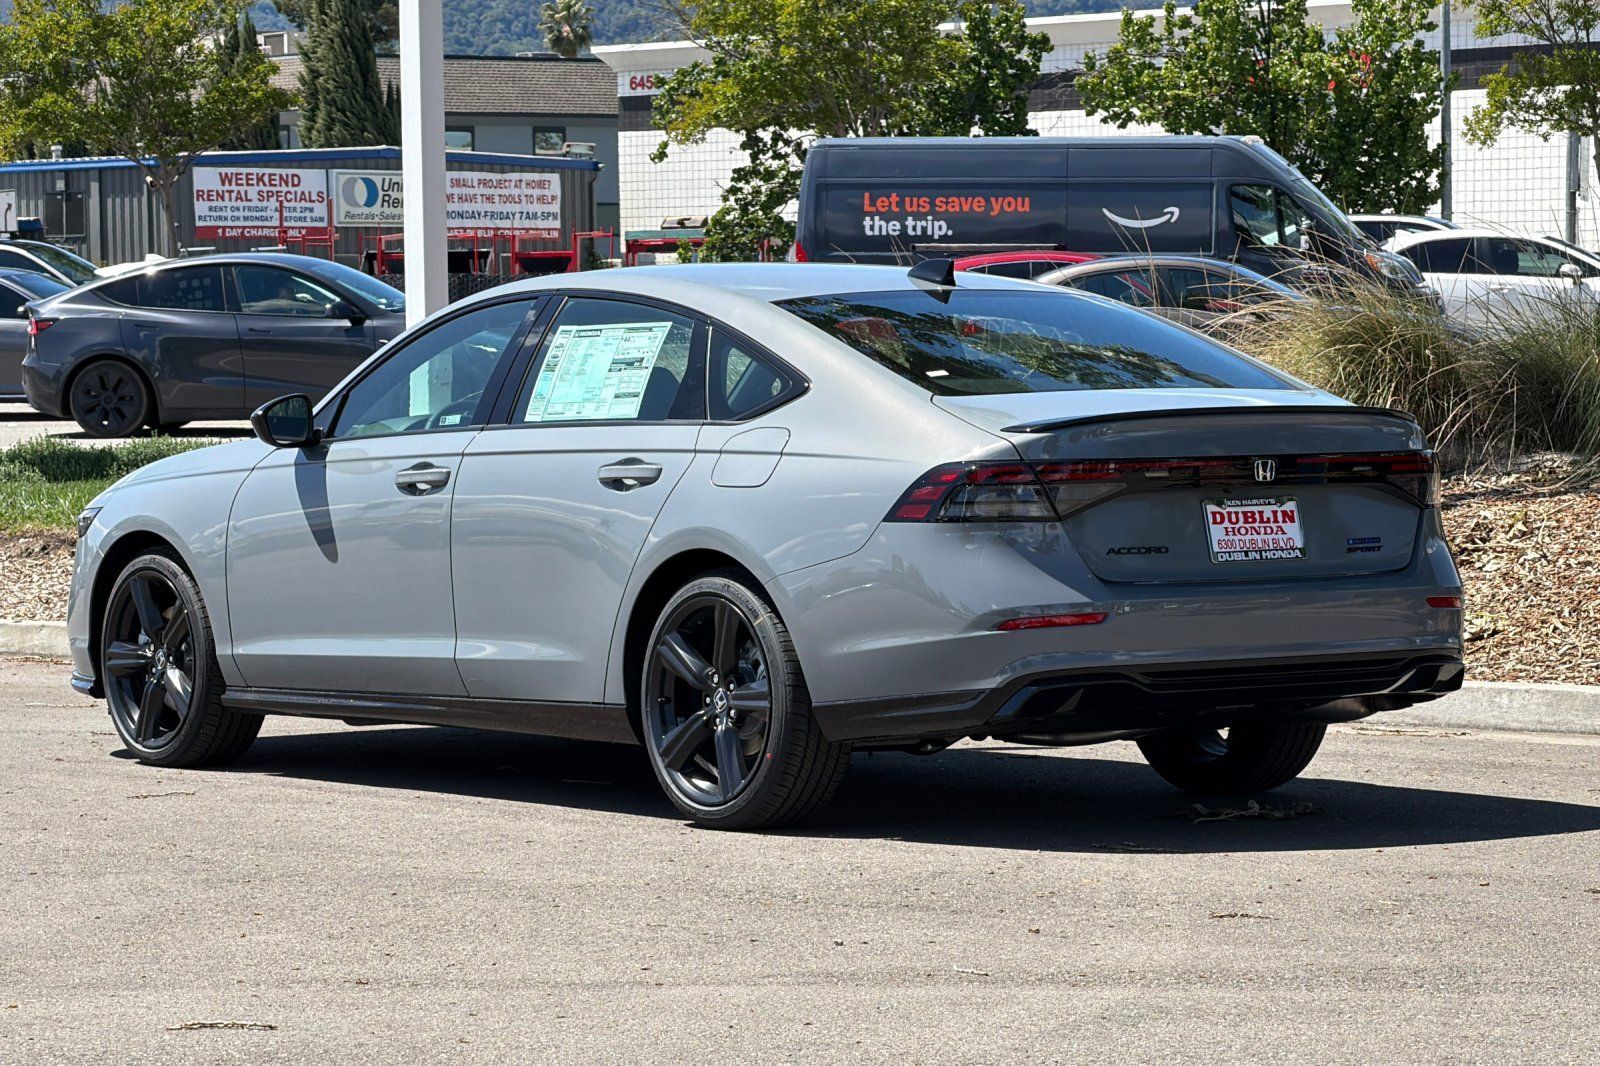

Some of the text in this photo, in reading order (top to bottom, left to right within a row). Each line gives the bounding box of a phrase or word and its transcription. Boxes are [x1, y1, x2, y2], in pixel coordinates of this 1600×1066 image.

[630, 75, 655, 90] 645
[219, 172, 302, 188] WEEKEND
[381, 178, 404, 192] Uni
[450, 178, 551, 190] SMALL PROJECT AT HOME?
[196, 190, 325, 204] RENTAL SPECIALS
[381, 194, 404, 208] Re
[458, 194, 478, 204] HAVE
[480, 194, 496, 204] THE
[498, 194, 522, 204] TOOLS
[524, 195, 534, 204] TO
[536, 195, 558, 205] HELP!
[864, 192, 1030, 216] Let us save you
[519, 211, 558, 221] 7AM-5PM
[226, 228, 243, 236] DAY
[244, 228, 280, 237] CHARGE
[286, 229, 306, 237] NLY
[863, 216, 953, 239] the trip.
[1210, 510, 1296, 525] DUBLIN
[1223, 526, 1287, 536] HONDA
[1106, 546, 1169, 555] ACCORD
[1218, 538, 1297, 550] 6300 DUBLIN BLVD.
[1218, 550, 1302, 562] DUBLIN HONDA
